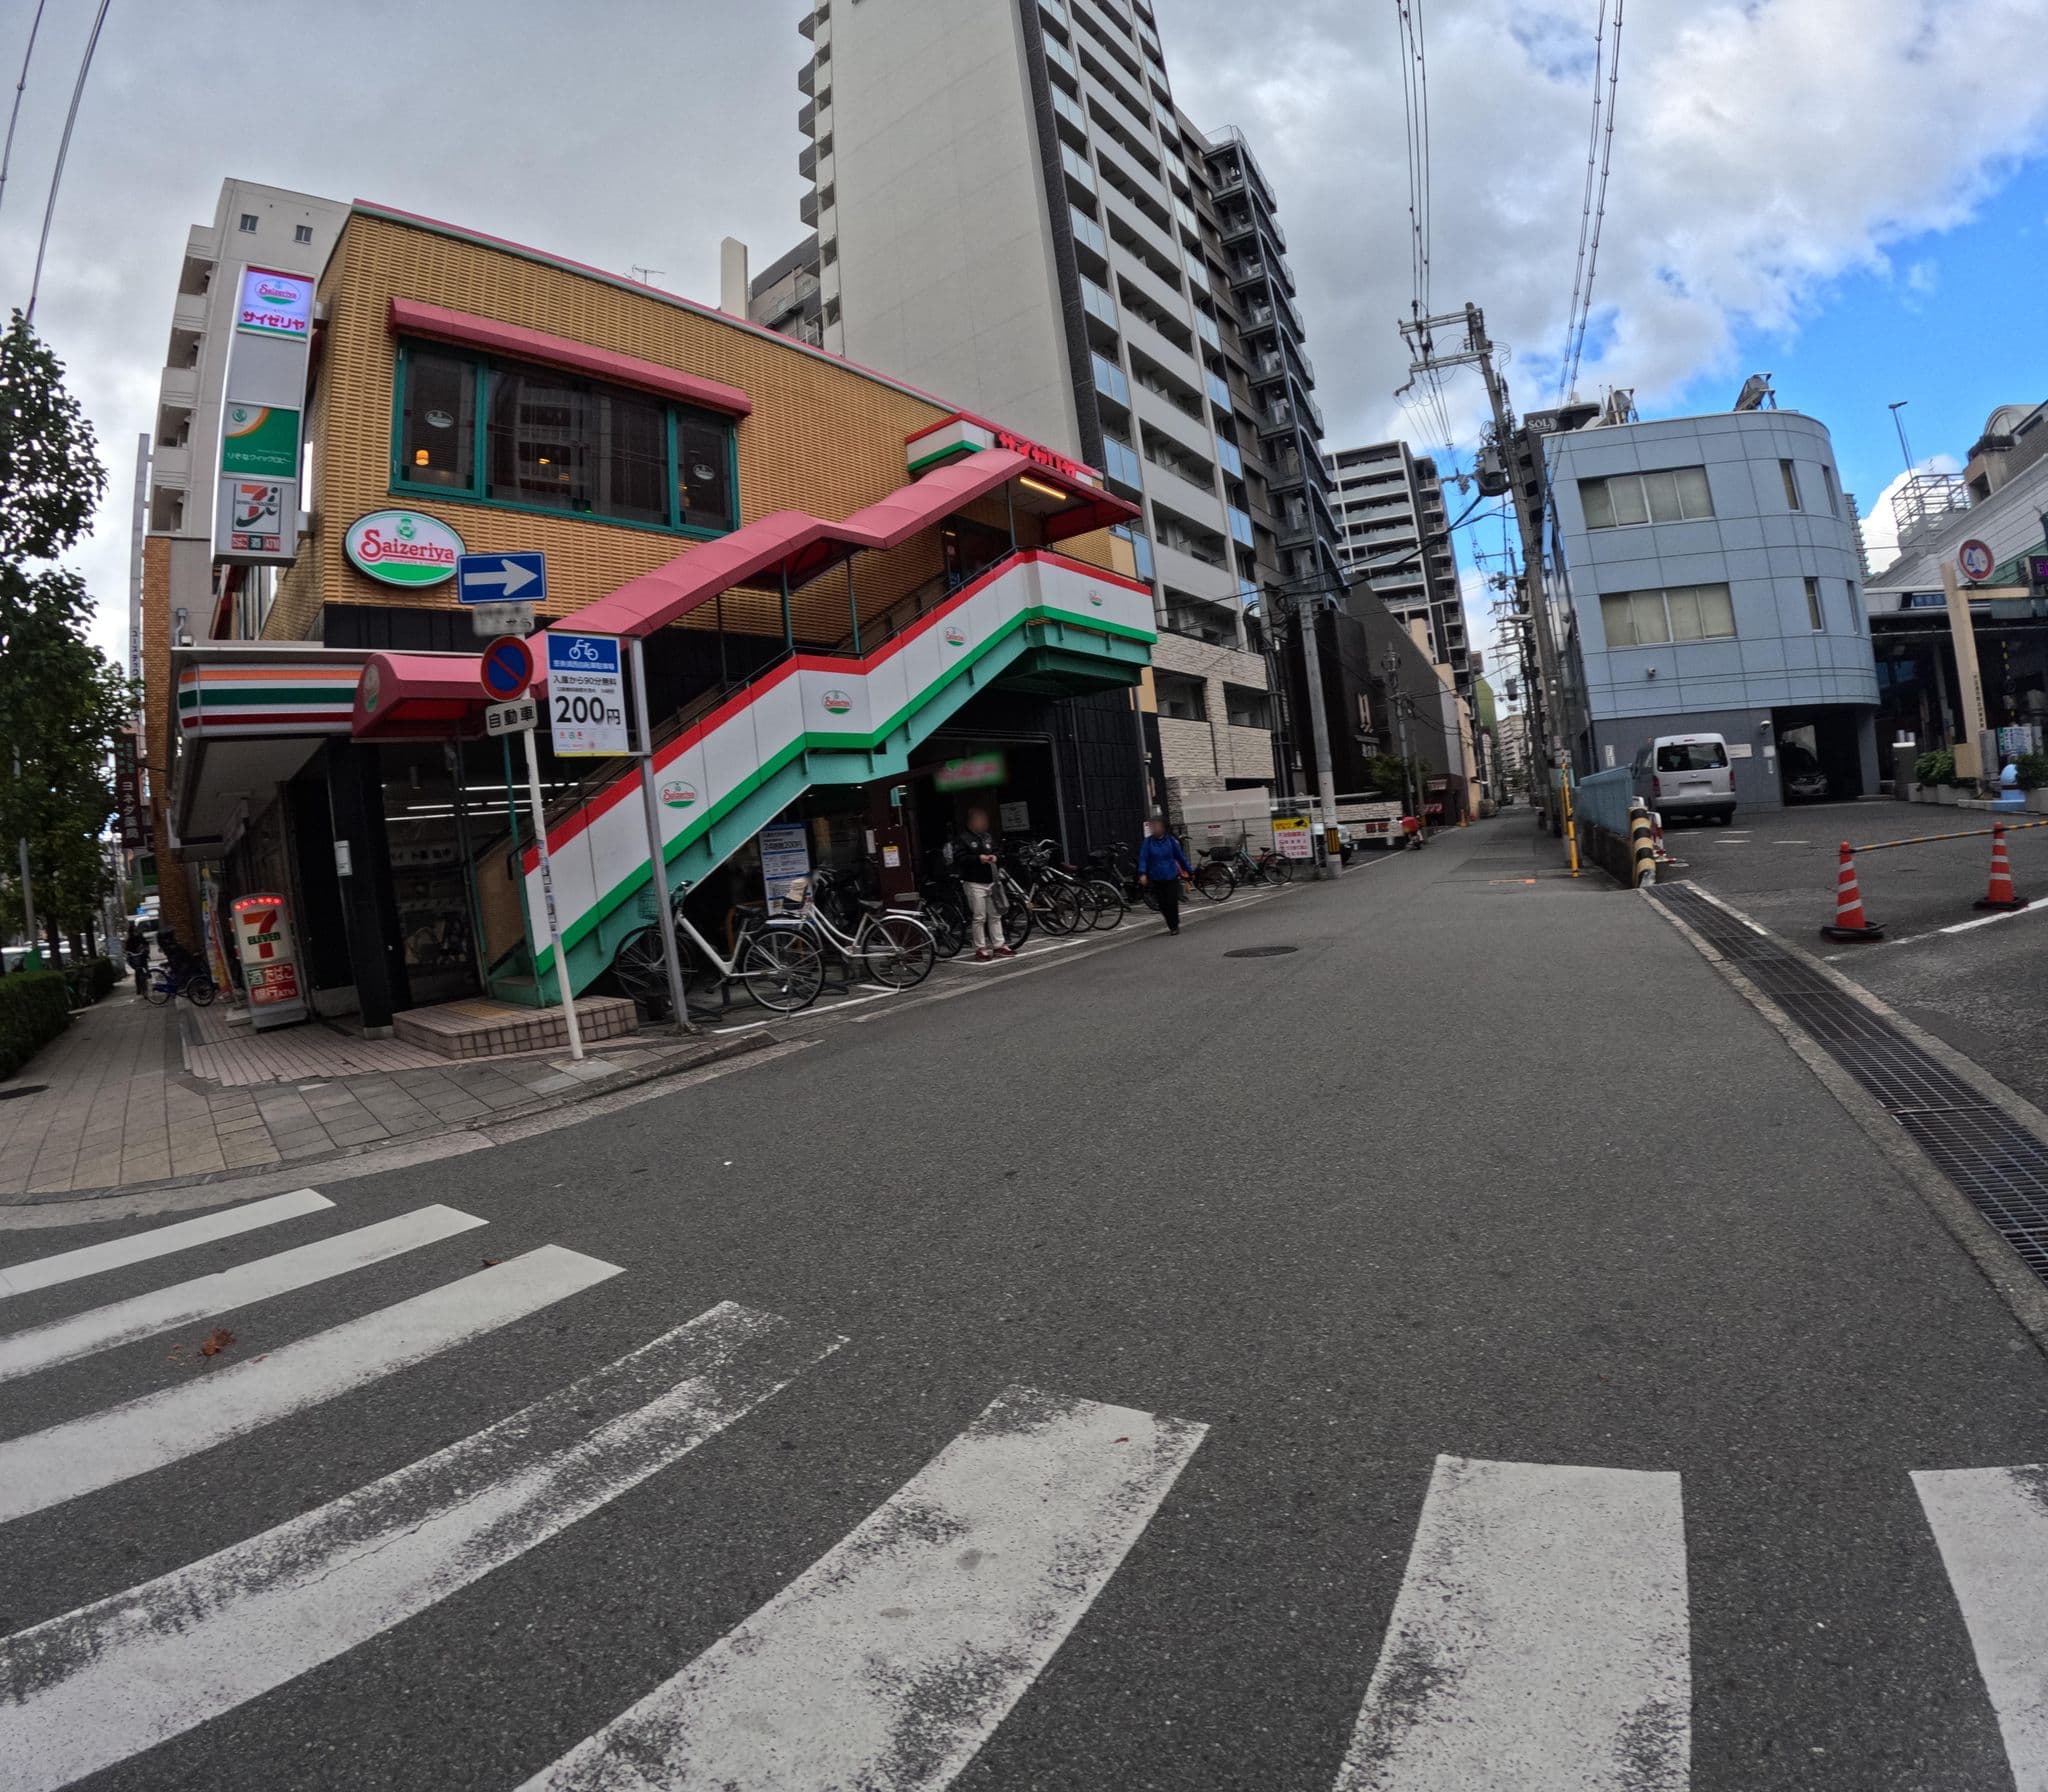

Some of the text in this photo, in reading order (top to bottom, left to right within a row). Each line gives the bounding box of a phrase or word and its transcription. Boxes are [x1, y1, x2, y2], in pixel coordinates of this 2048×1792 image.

[243, 311, 305, 331] サイゼリヤ
[357, 528, 455, 564] Saizeriya
[488, 705, 535, 729] 自動車
[555, 695, 622, 726] 200円
